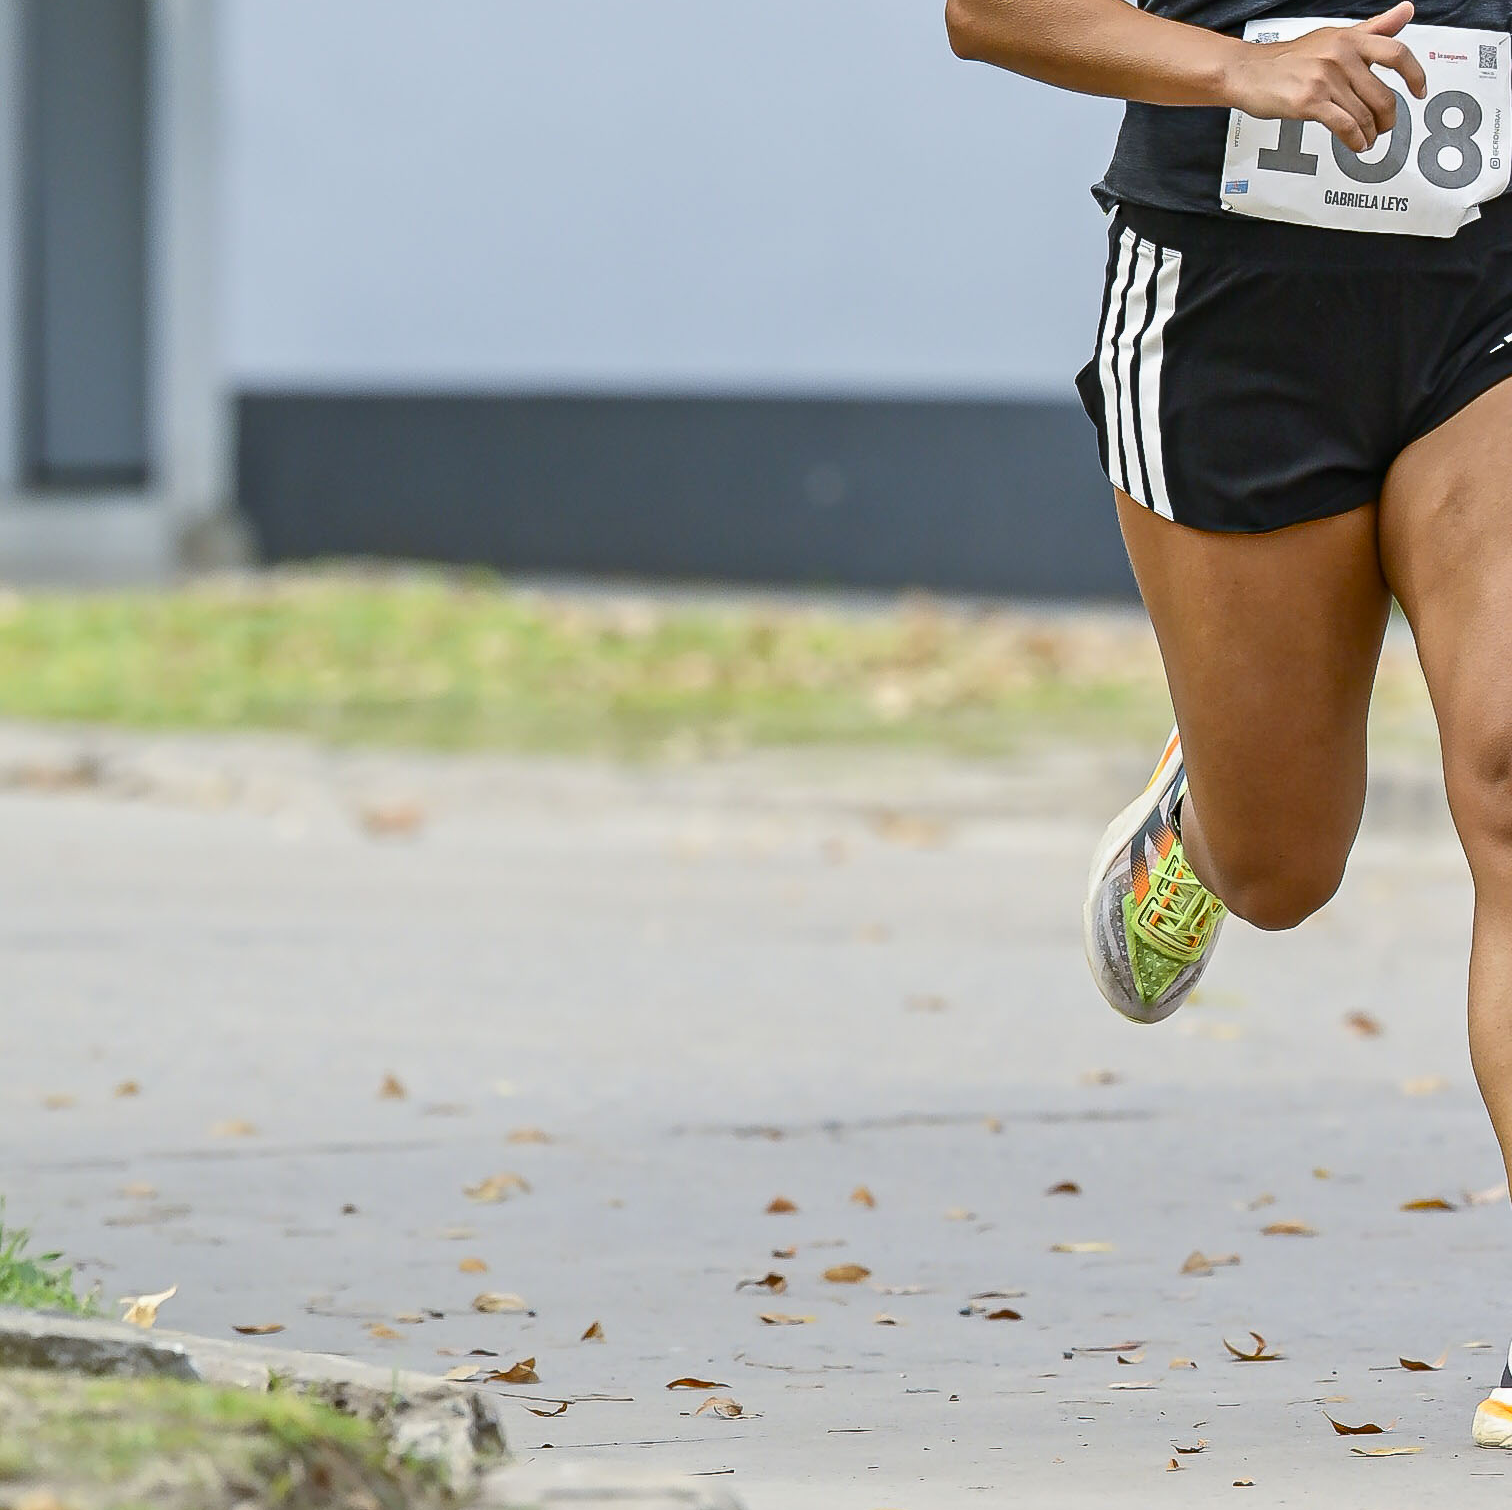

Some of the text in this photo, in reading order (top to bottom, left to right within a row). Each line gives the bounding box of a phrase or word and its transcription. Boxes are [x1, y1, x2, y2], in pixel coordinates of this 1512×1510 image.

[1257, 88, 1483, 189] 108
[1324, 189, 1409, 212] GABRIELA LEYS
